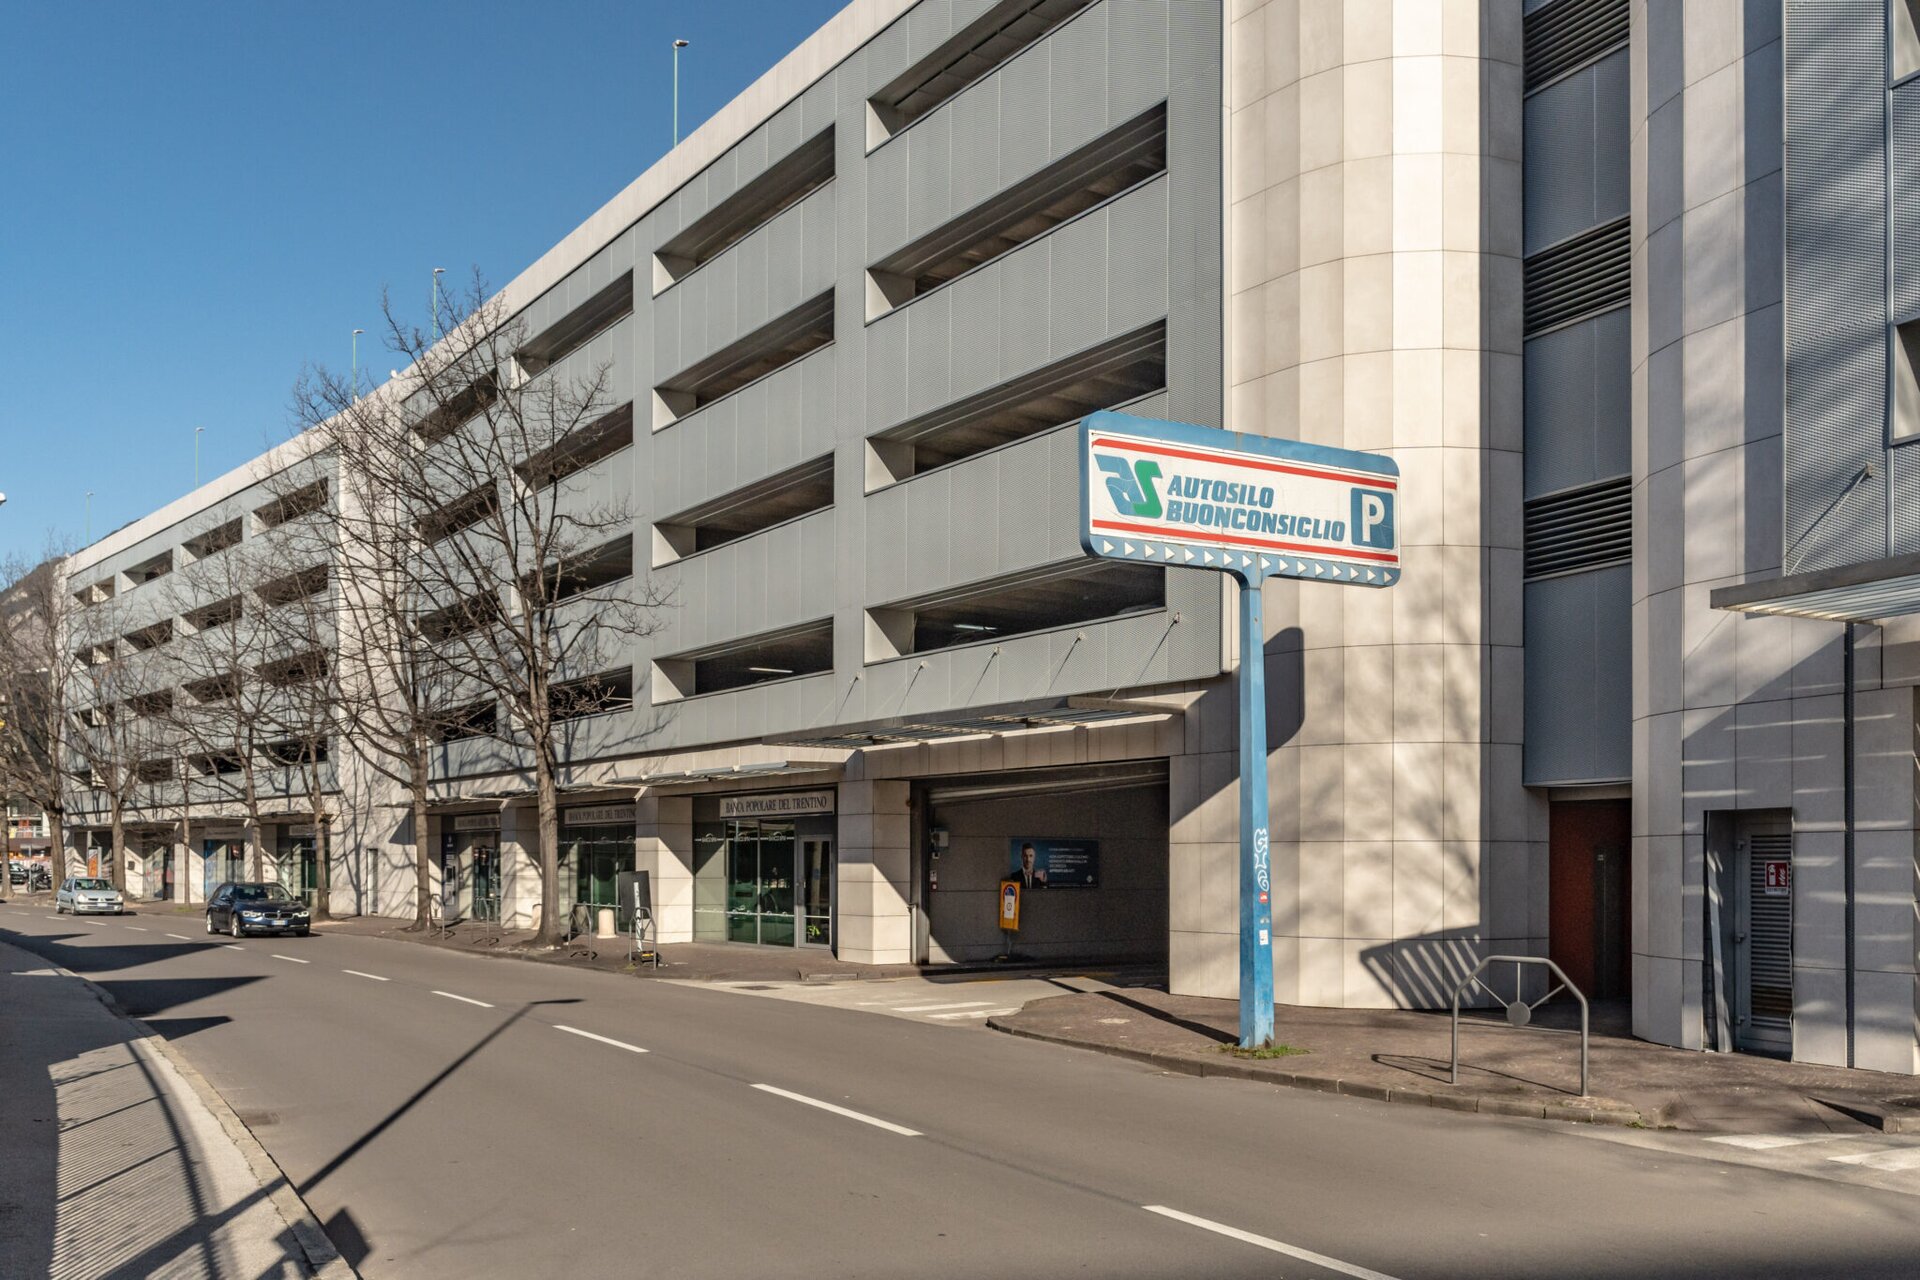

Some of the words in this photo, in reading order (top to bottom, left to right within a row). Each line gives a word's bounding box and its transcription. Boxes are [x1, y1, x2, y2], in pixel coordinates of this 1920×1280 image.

[1167, 475, 1274, 508] AUTOSILO
[1165, 500, 1345, 542] BUONCONSIGLIO
[1362, 494, 1386, 542] P
[726, 802, 744, 813] BANCA
[746, 799, 776, 812] POPOLARE
[778, 799, 791, 810] DEL
[792, 796, 827, 809] TRENTINO
